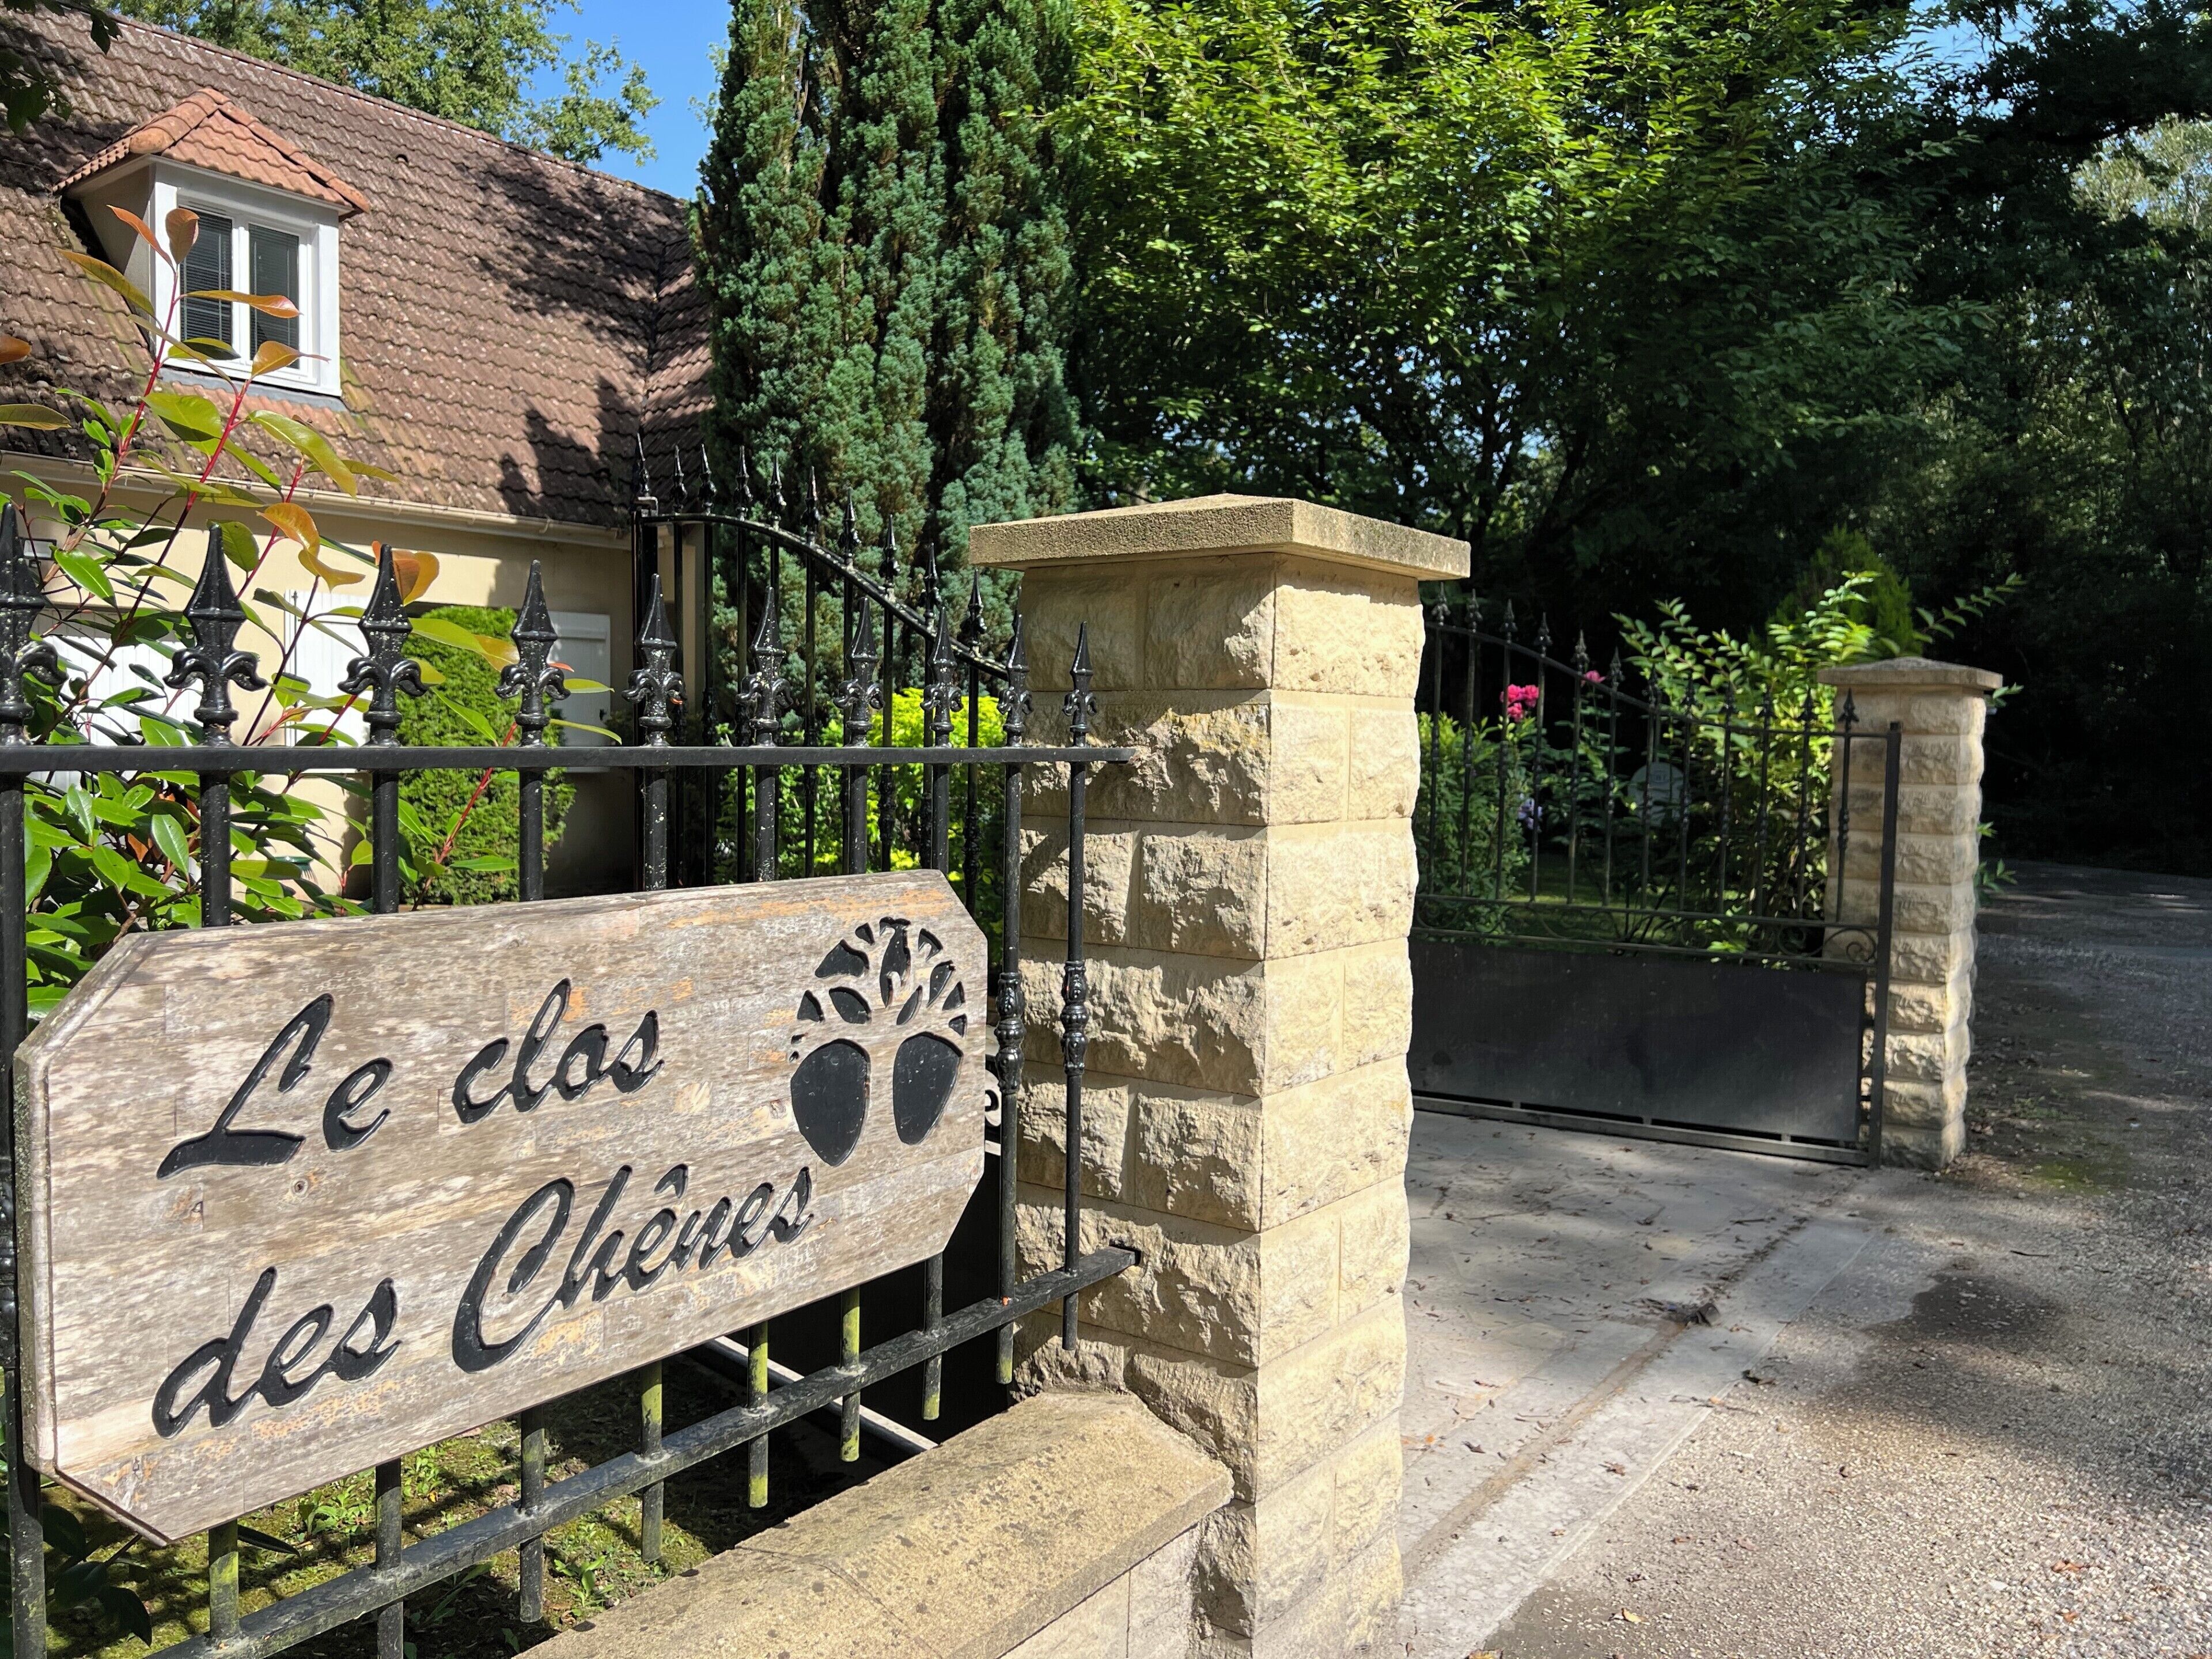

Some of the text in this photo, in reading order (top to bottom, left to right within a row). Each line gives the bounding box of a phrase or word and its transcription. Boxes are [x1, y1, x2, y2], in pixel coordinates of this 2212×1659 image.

[157, 979, 665, 1179] Le clos
[152, 1164, 814, 1438] des Chênes
